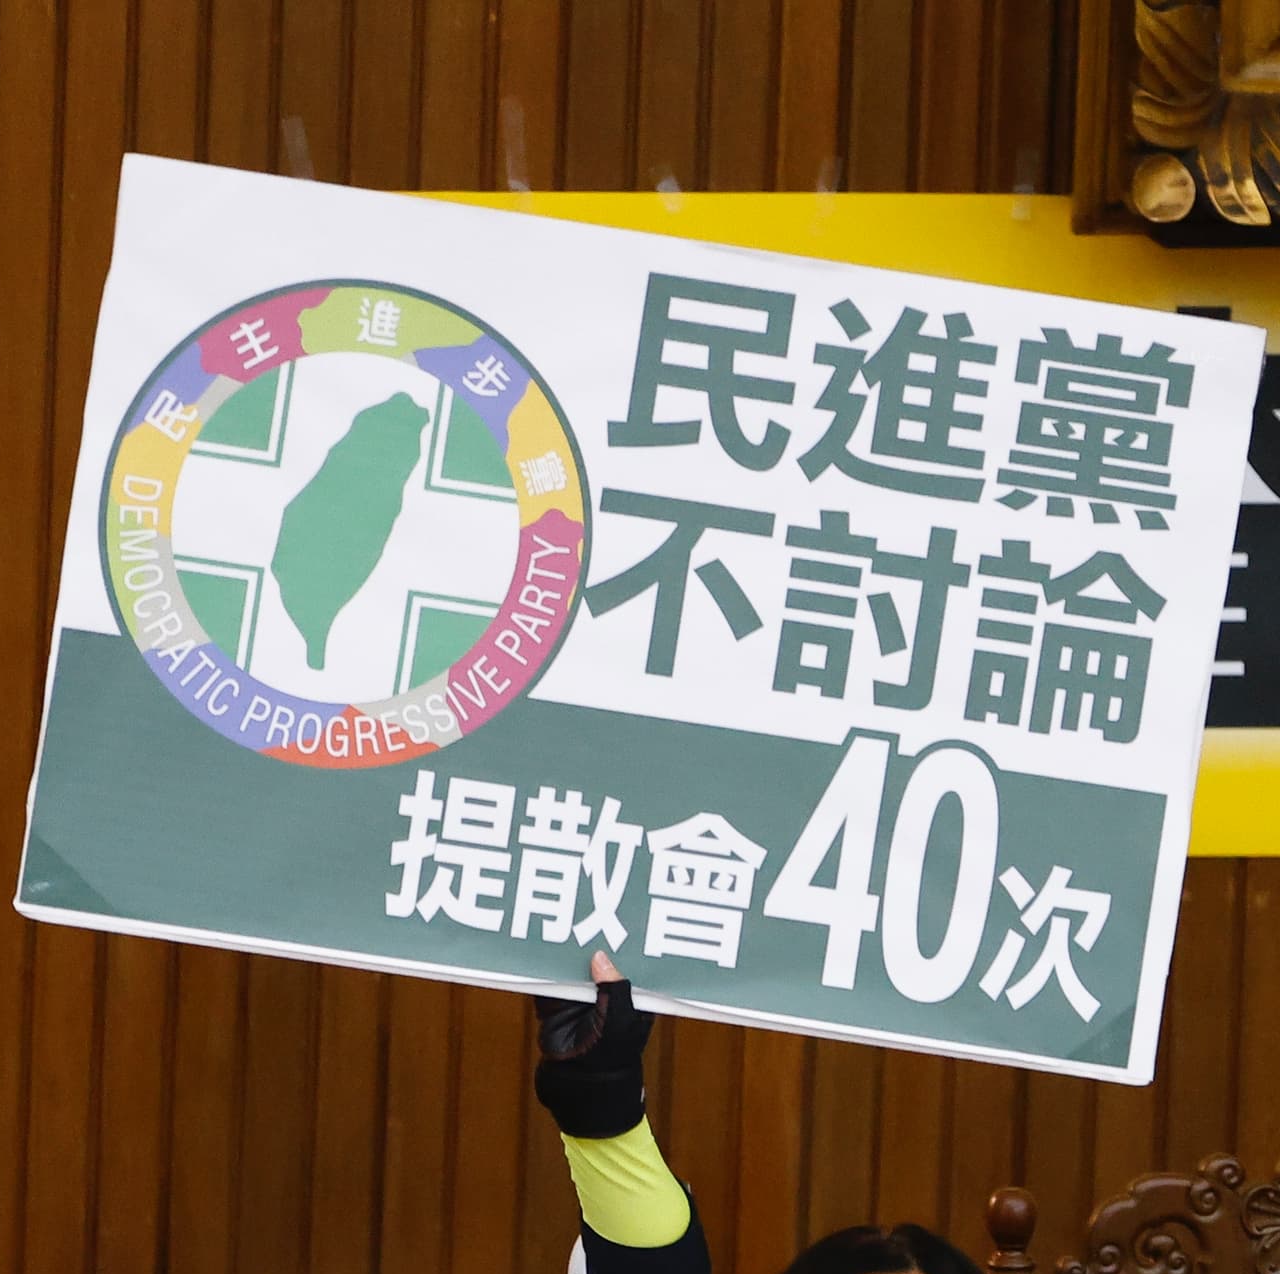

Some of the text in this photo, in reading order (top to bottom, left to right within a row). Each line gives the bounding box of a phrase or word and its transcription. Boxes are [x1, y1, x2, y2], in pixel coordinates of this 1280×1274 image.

[144, 297, 567, 496] 民主進步黨
[608, 271, 1197, 531] 民進黨
[119, 474, 571, 758] DEMOCRATIC PROGRESSIVE PARTY
[583, 488, 1166, 744] 不討論
[385, 735, 1115, 1024] 提散會40次
